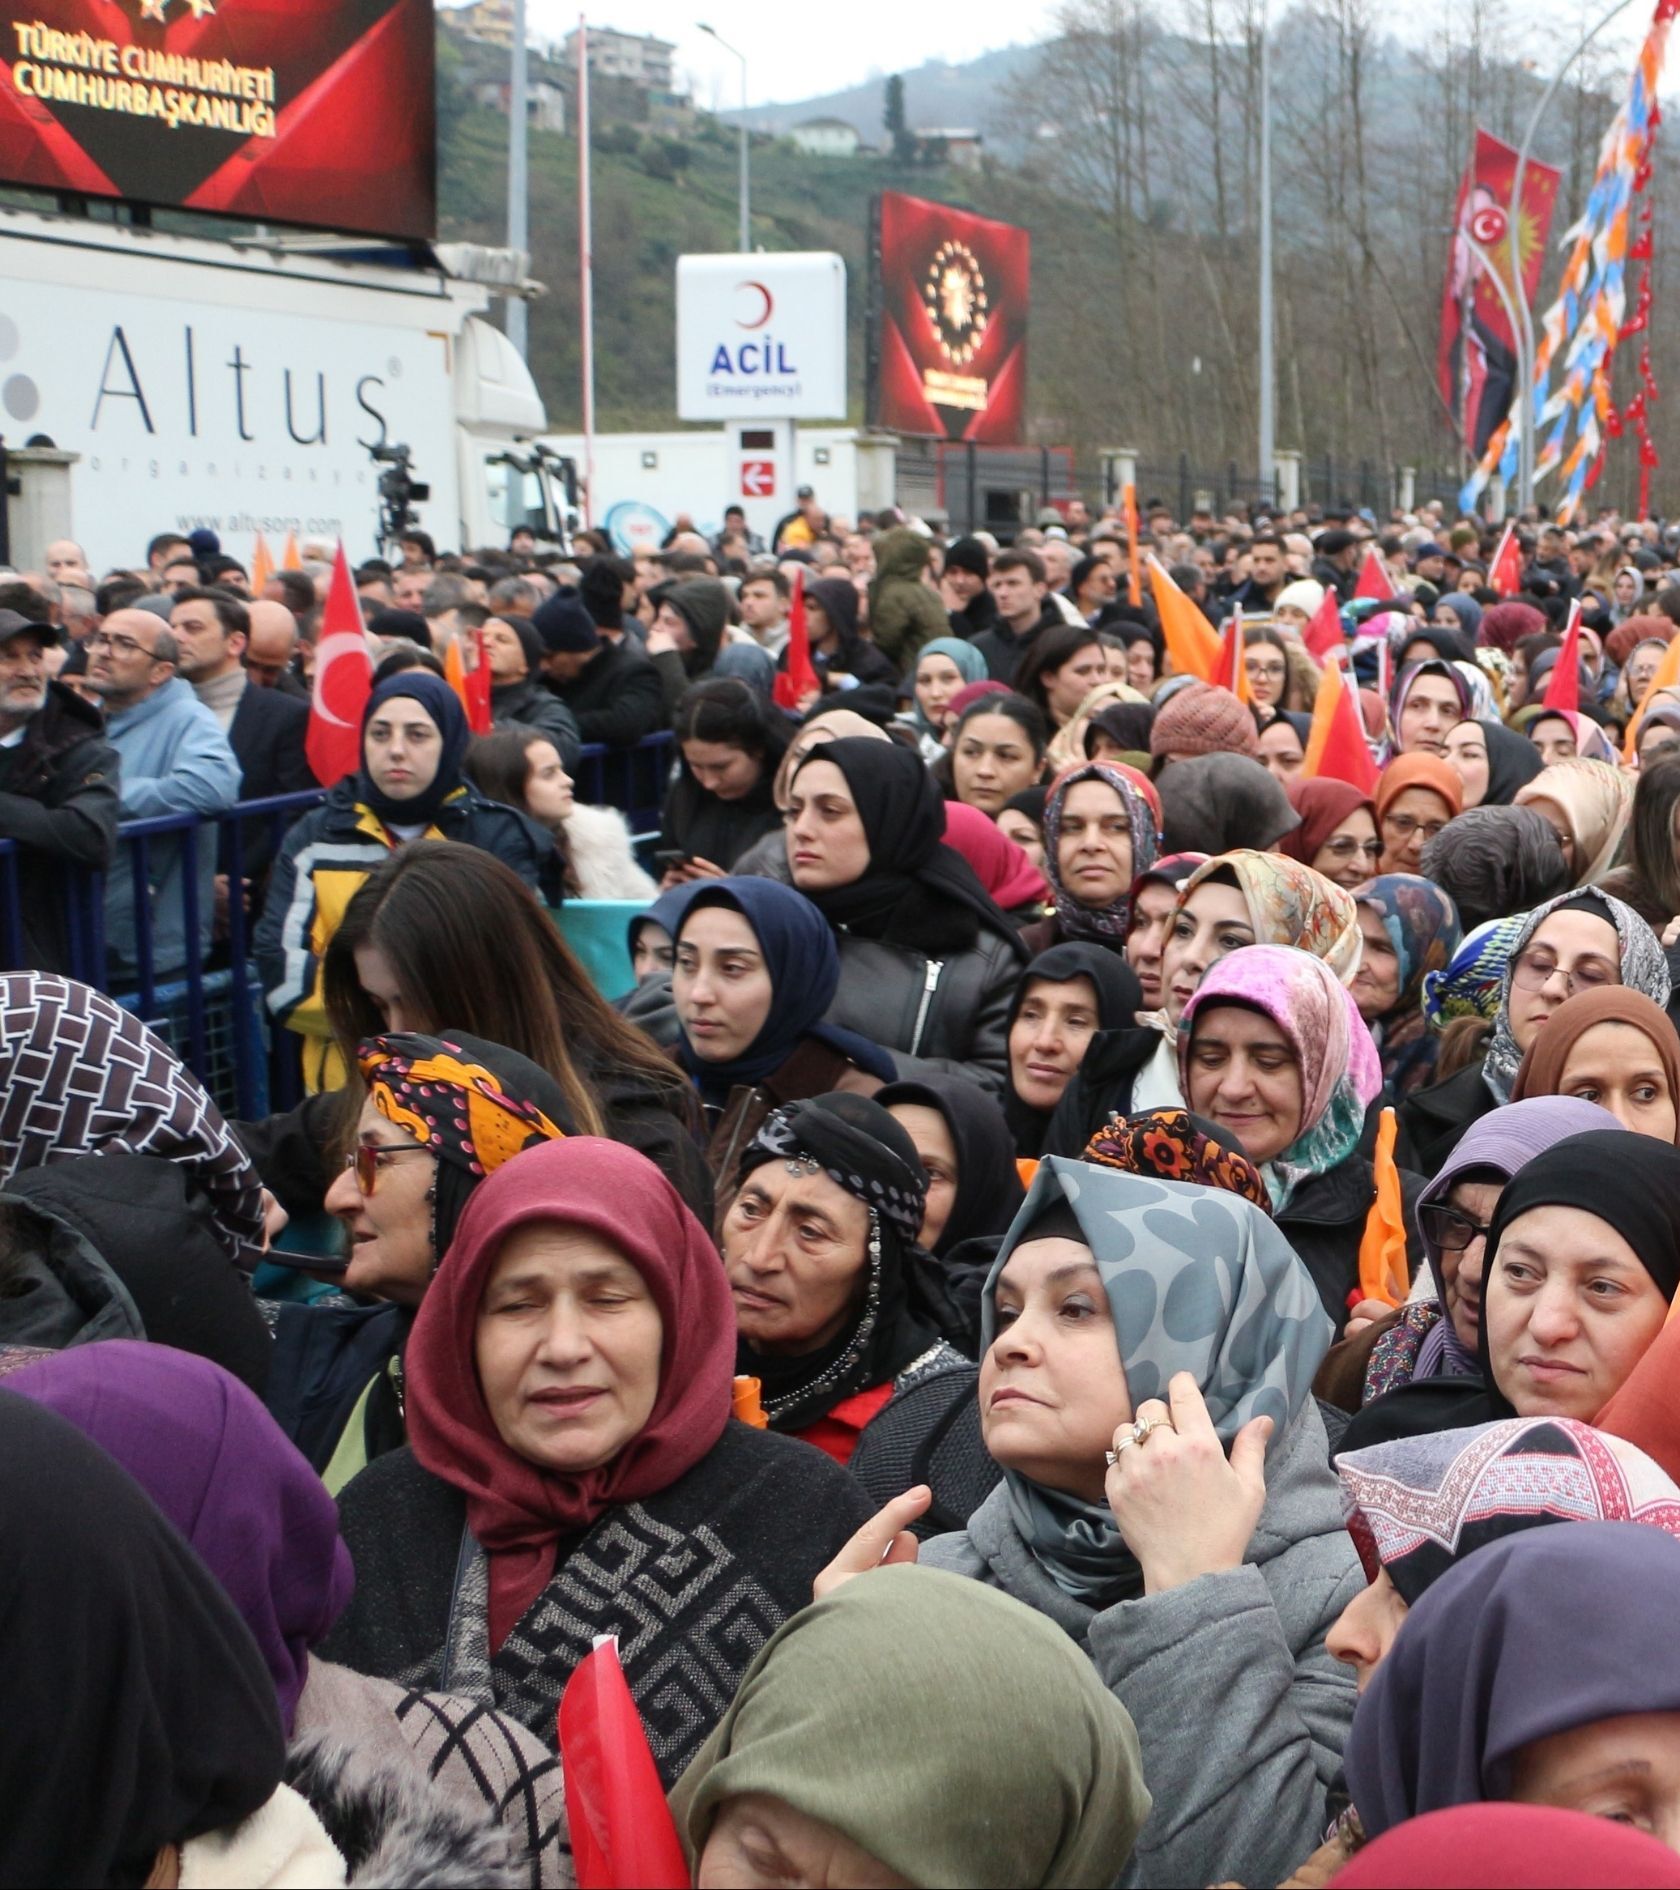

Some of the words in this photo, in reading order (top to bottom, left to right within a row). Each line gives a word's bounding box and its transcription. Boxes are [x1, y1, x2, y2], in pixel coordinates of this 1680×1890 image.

[12, 20, 119, 74] TÜRKİYE
[120, 44, 275, 102] CUMHURİYETİ
[12, 60, 276, 138] CUMHURBAŞKANLIĞI
[90, 324, 388, 449] Altus
[710, 333, 797, 375] ACİL
